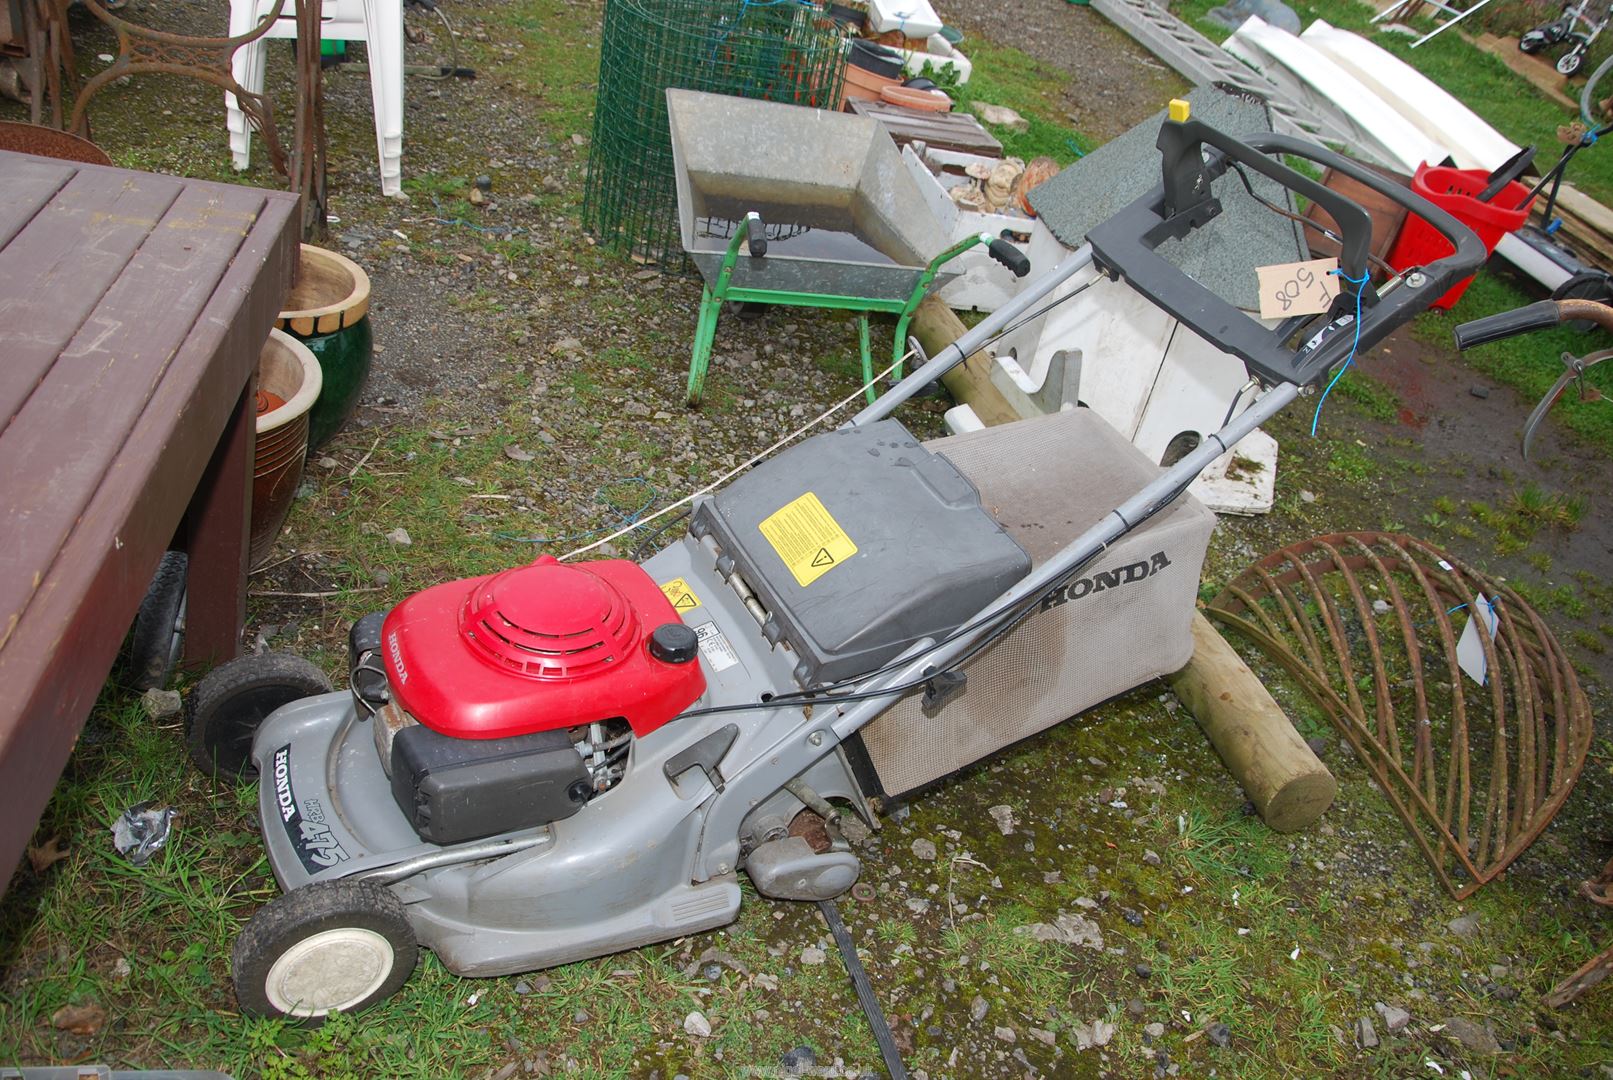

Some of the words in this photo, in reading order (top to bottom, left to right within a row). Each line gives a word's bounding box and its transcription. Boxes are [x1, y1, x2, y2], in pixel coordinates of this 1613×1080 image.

[1275, 266, 1315, 311] 508
[1319, 280, 1332, 309] F
[1039, 550, 1172, 614] HONDA
[388, 631, 409, 686] HONDA
[273, 749, 296, 823] HONDA
